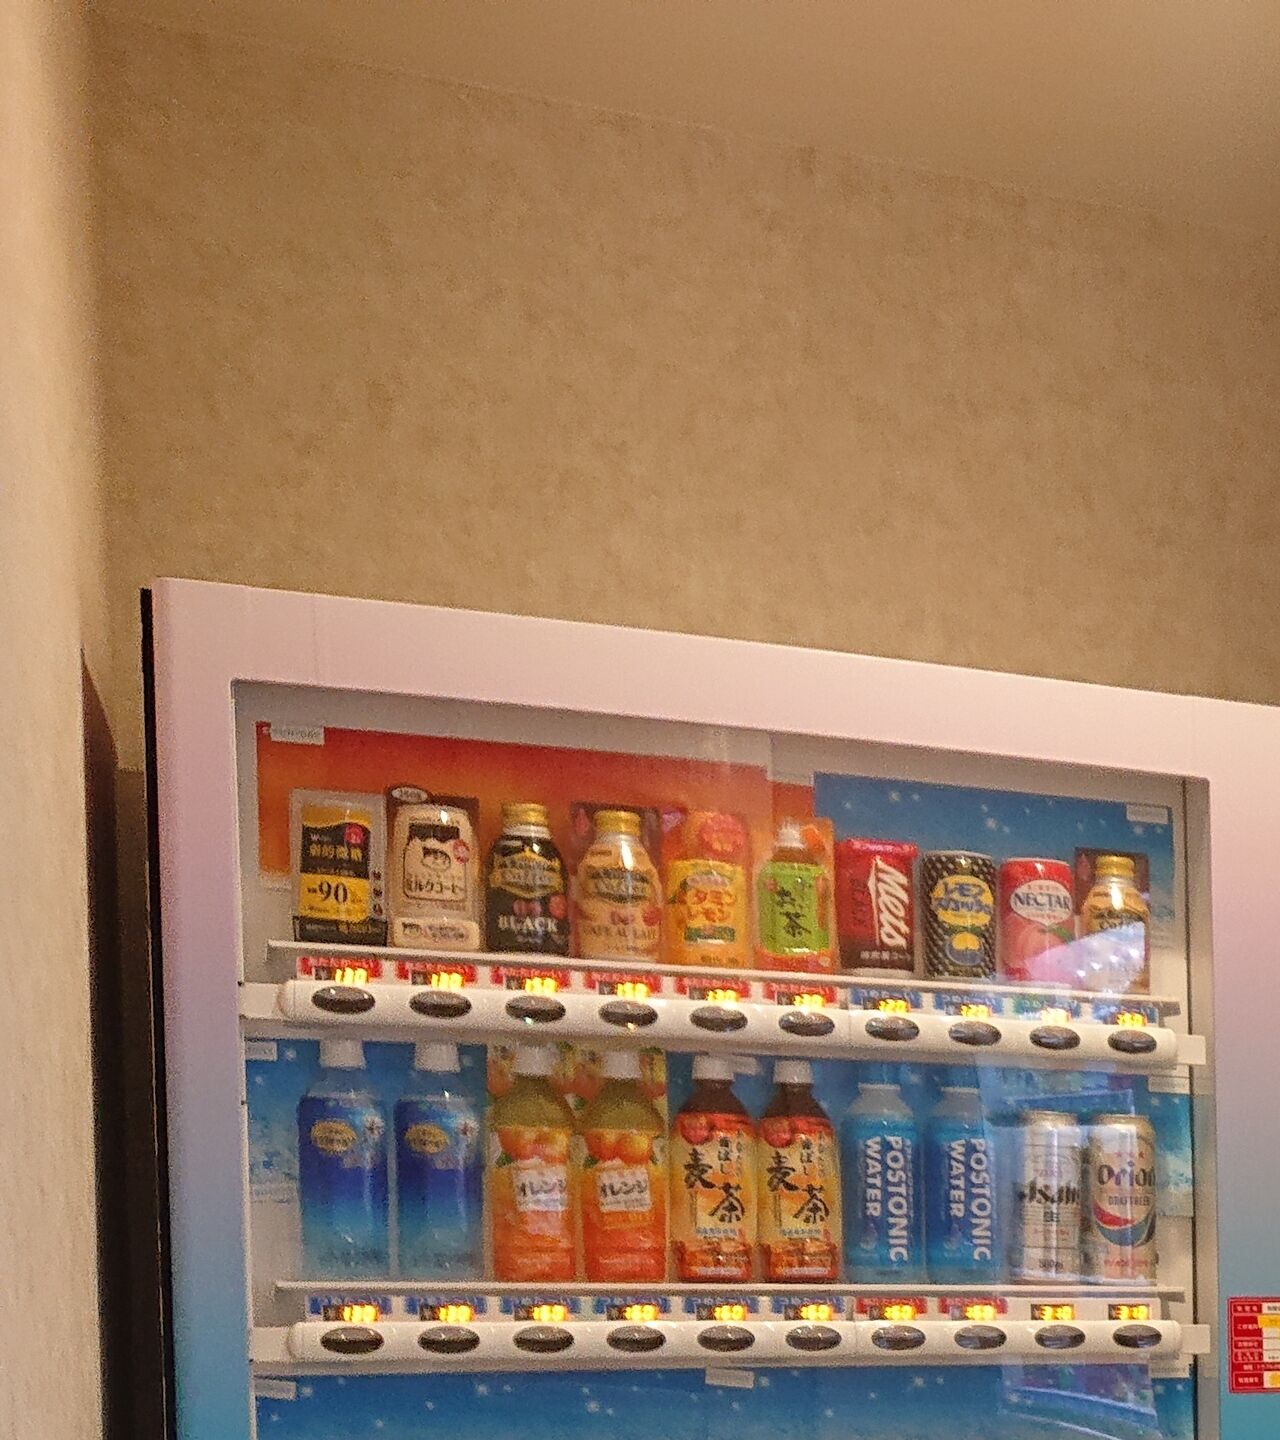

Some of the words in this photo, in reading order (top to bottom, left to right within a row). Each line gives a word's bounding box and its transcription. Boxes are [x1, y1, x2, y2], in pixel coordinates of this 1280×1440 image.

[498, 914, 558, 934] BLACK
[874, 854, 911, 951] Mets
[1013, 891, 1072, 907] NECTAR
[600, 1178, 648, 1198] オレンジ
[864, 1136, 882, 1218] WATER
[884, 1133, 910, 1264] POSTONIC
[949, 1138, 965, 1219] WATER
[969, 1137, 992, 1262] POSTONIC
[1097, 1159, 1157, 1188] Orion
